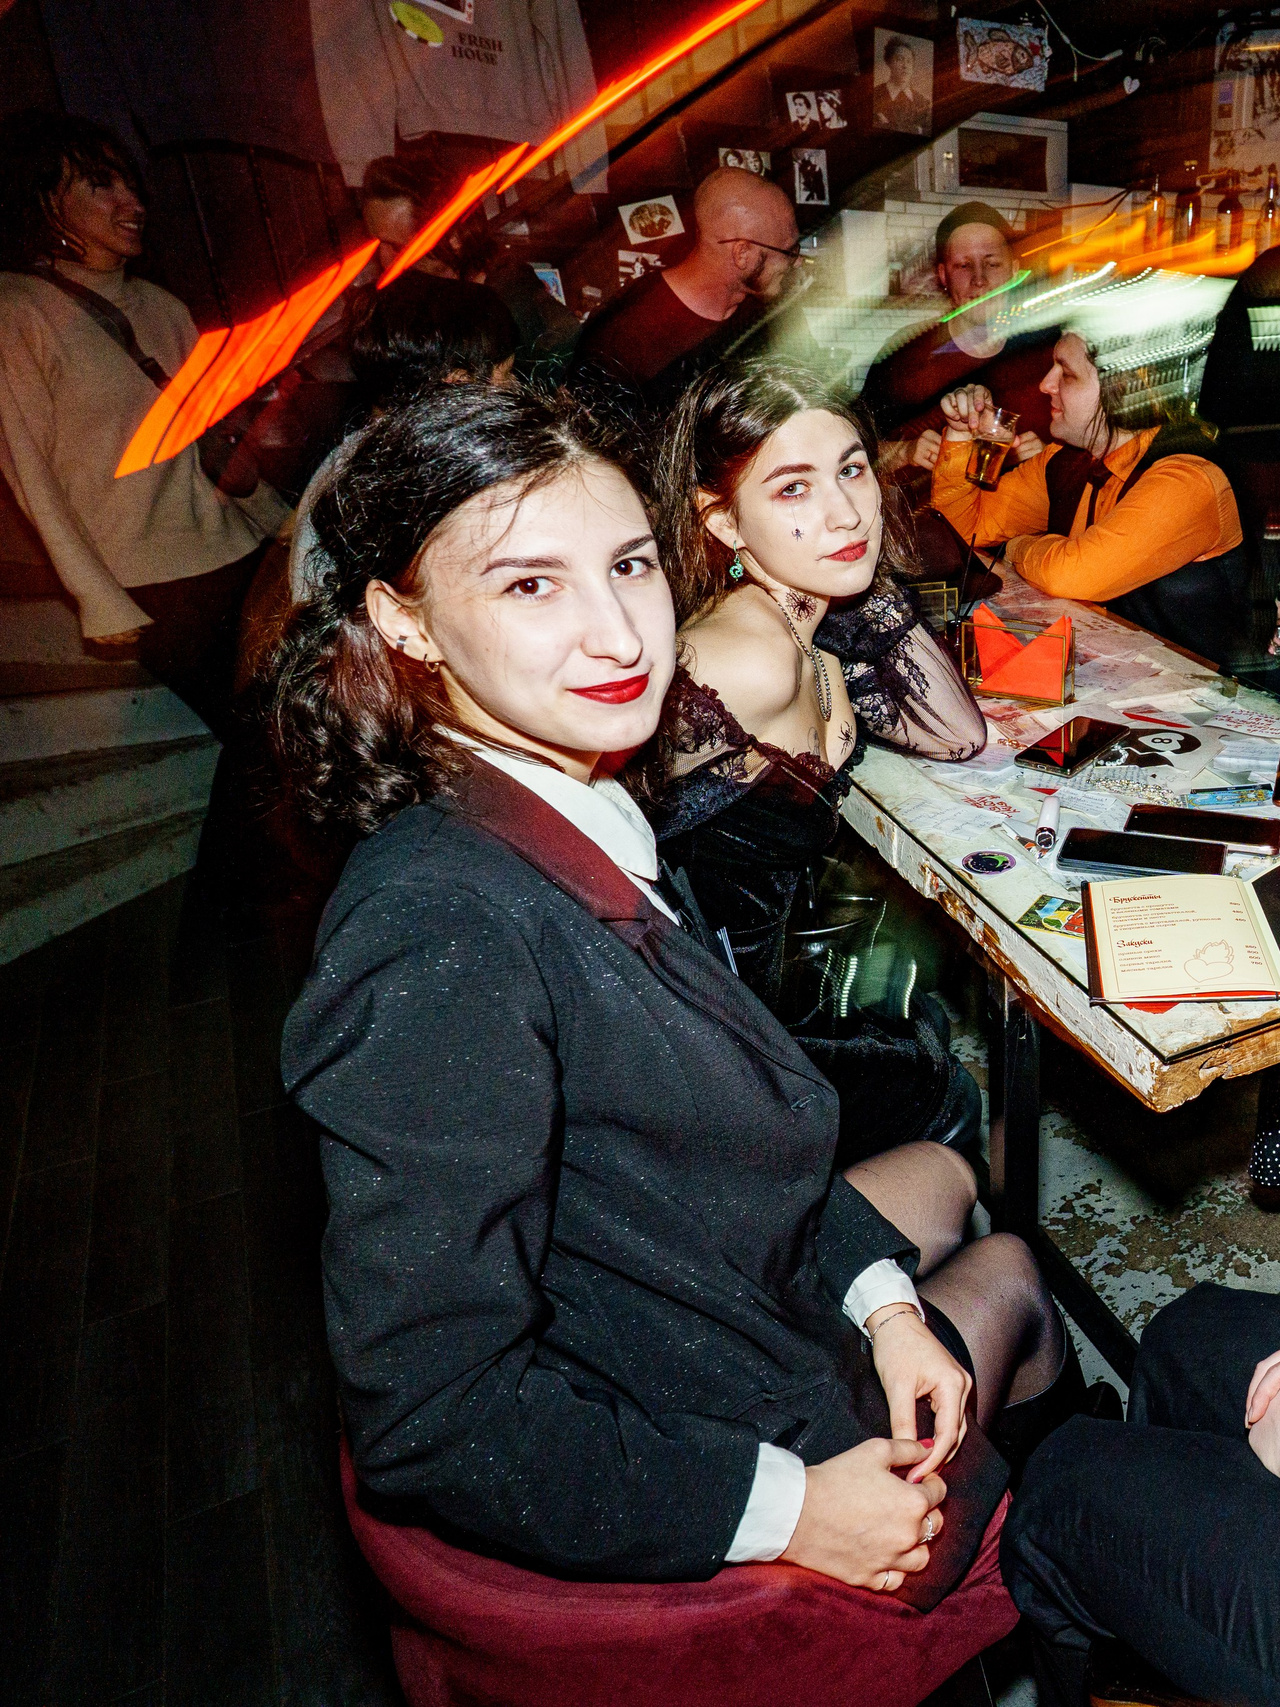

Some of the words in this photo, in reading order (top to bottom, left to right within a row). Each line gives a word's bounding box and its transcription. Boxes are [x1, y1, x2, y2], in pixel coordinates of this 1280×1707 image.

[458, 32, 503, 52] FRESH
[451, 45, 499, 66] HOUSE
[1109, 894, 1162, 904] Брускетты
[1116, 937, 1153, 949] Закуски
